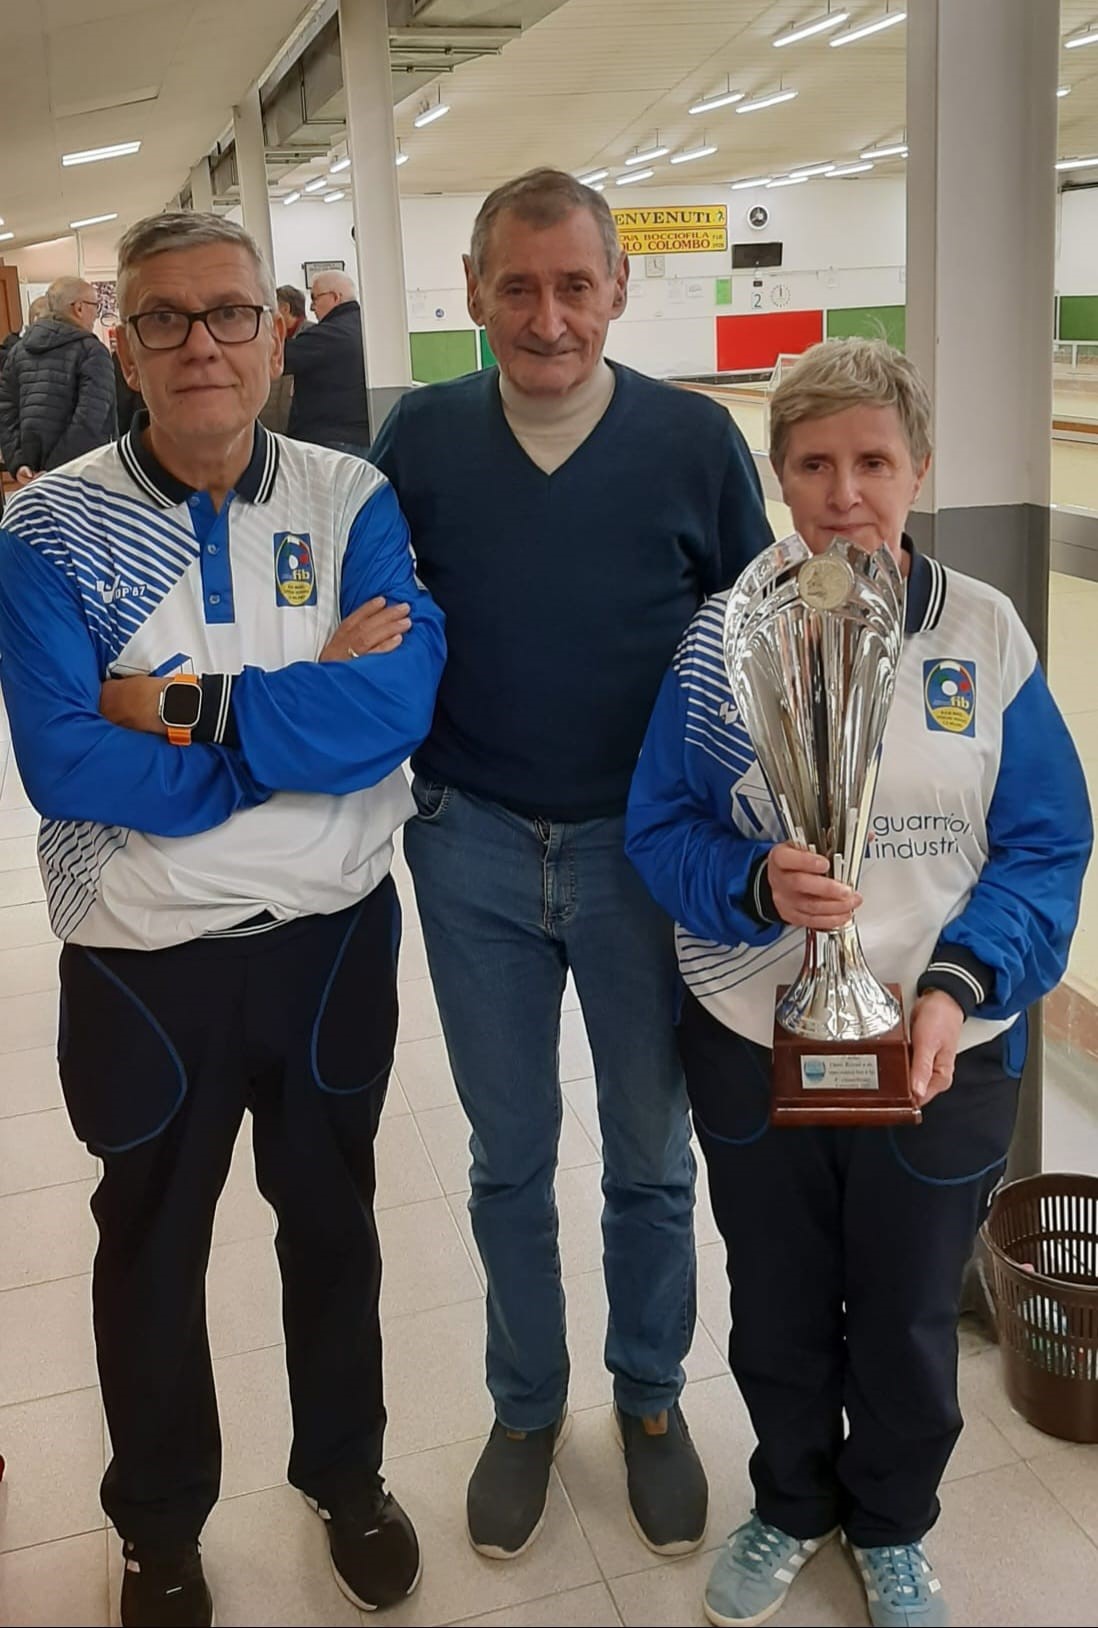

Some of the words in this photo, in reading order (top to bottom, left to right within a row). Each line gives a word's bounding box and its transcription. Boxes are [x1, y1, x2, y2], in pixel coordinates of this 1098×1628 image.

[614, 211, 711, 225] ENVENUTI
[644, 231, 710, 241] BOCCIOFILA
[620, 241, 642, 252] OLO
[648, 239, 711, 251] COLOMBO
[754, 293, 762, 308] 2
[875, 837, 959, 859] industri
